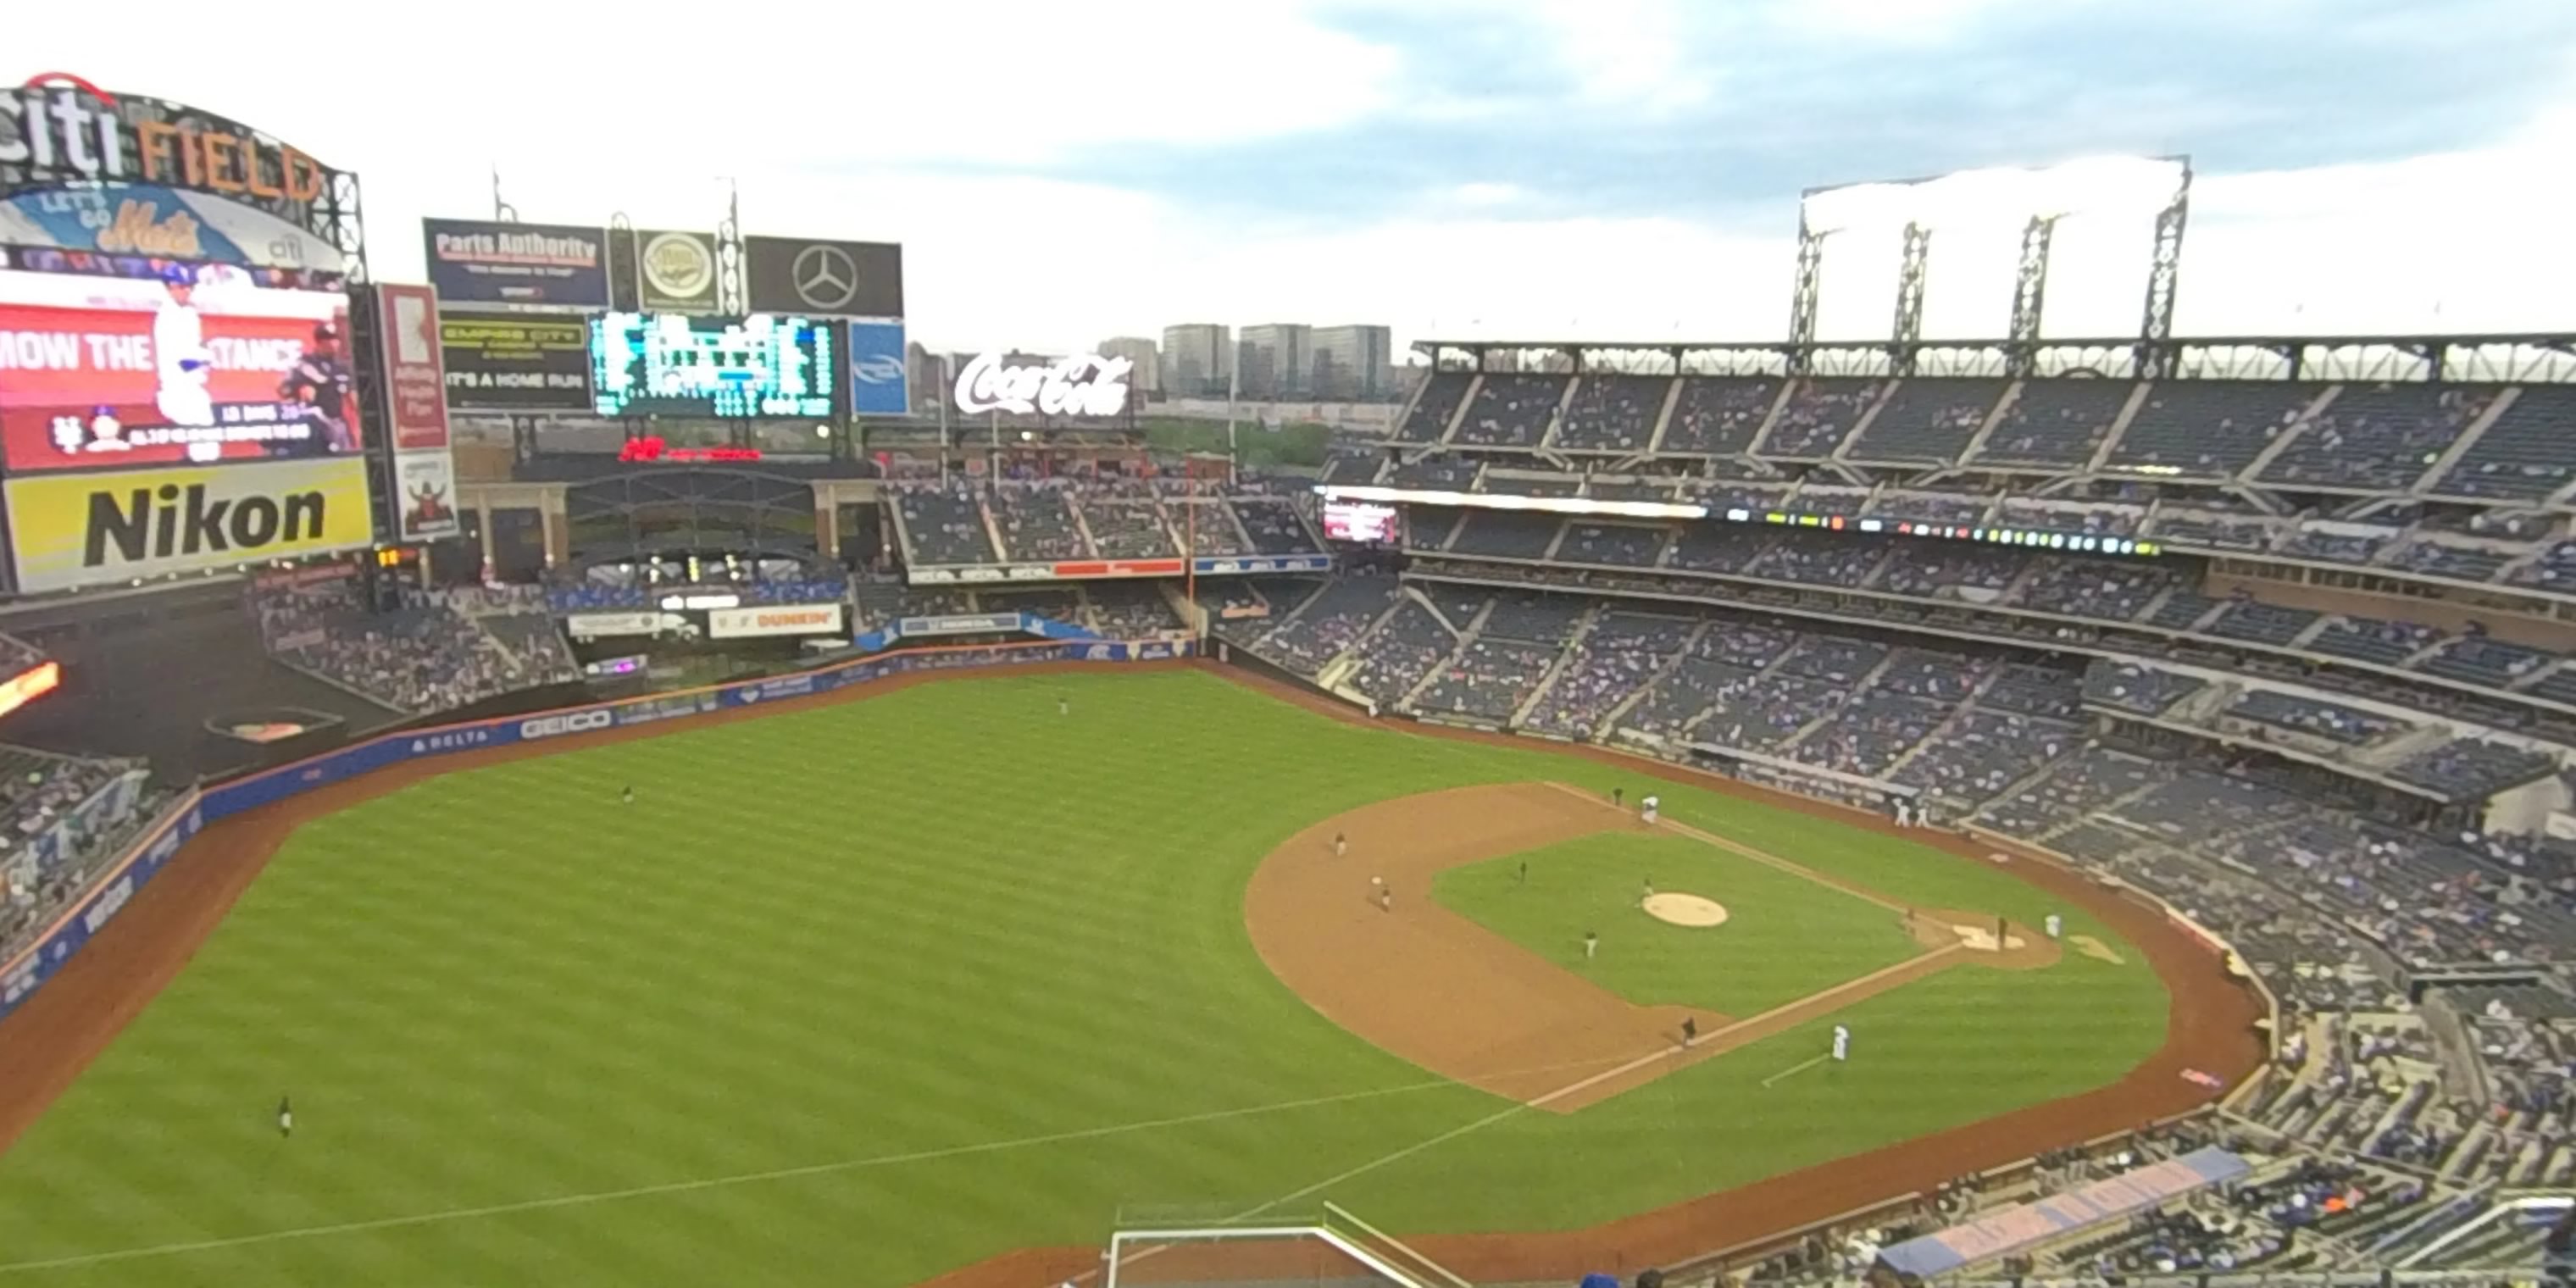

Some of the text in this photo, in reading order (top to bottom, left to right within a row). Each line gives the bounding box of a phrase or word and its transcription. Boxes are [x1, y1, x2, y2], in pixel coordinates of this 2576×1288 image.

[136, 120, 322, 203] FIELD
[80, 208, 112, 229] GO
[97, 197, 202, 255] Mets
[435, 232, 495, 257] Parts
[497, 231, 597, 258] Authority
[86, 333, 153, 373] THE
[480, 372, 493, 387] A
[496, 372, 545, 389] HOME
[547, 373, 584, 389] RUN
[82, 483, 326, 568] Nikon
[519, 709, 612, 740] GEICO
[430, 730, 488, 751] DELTA
